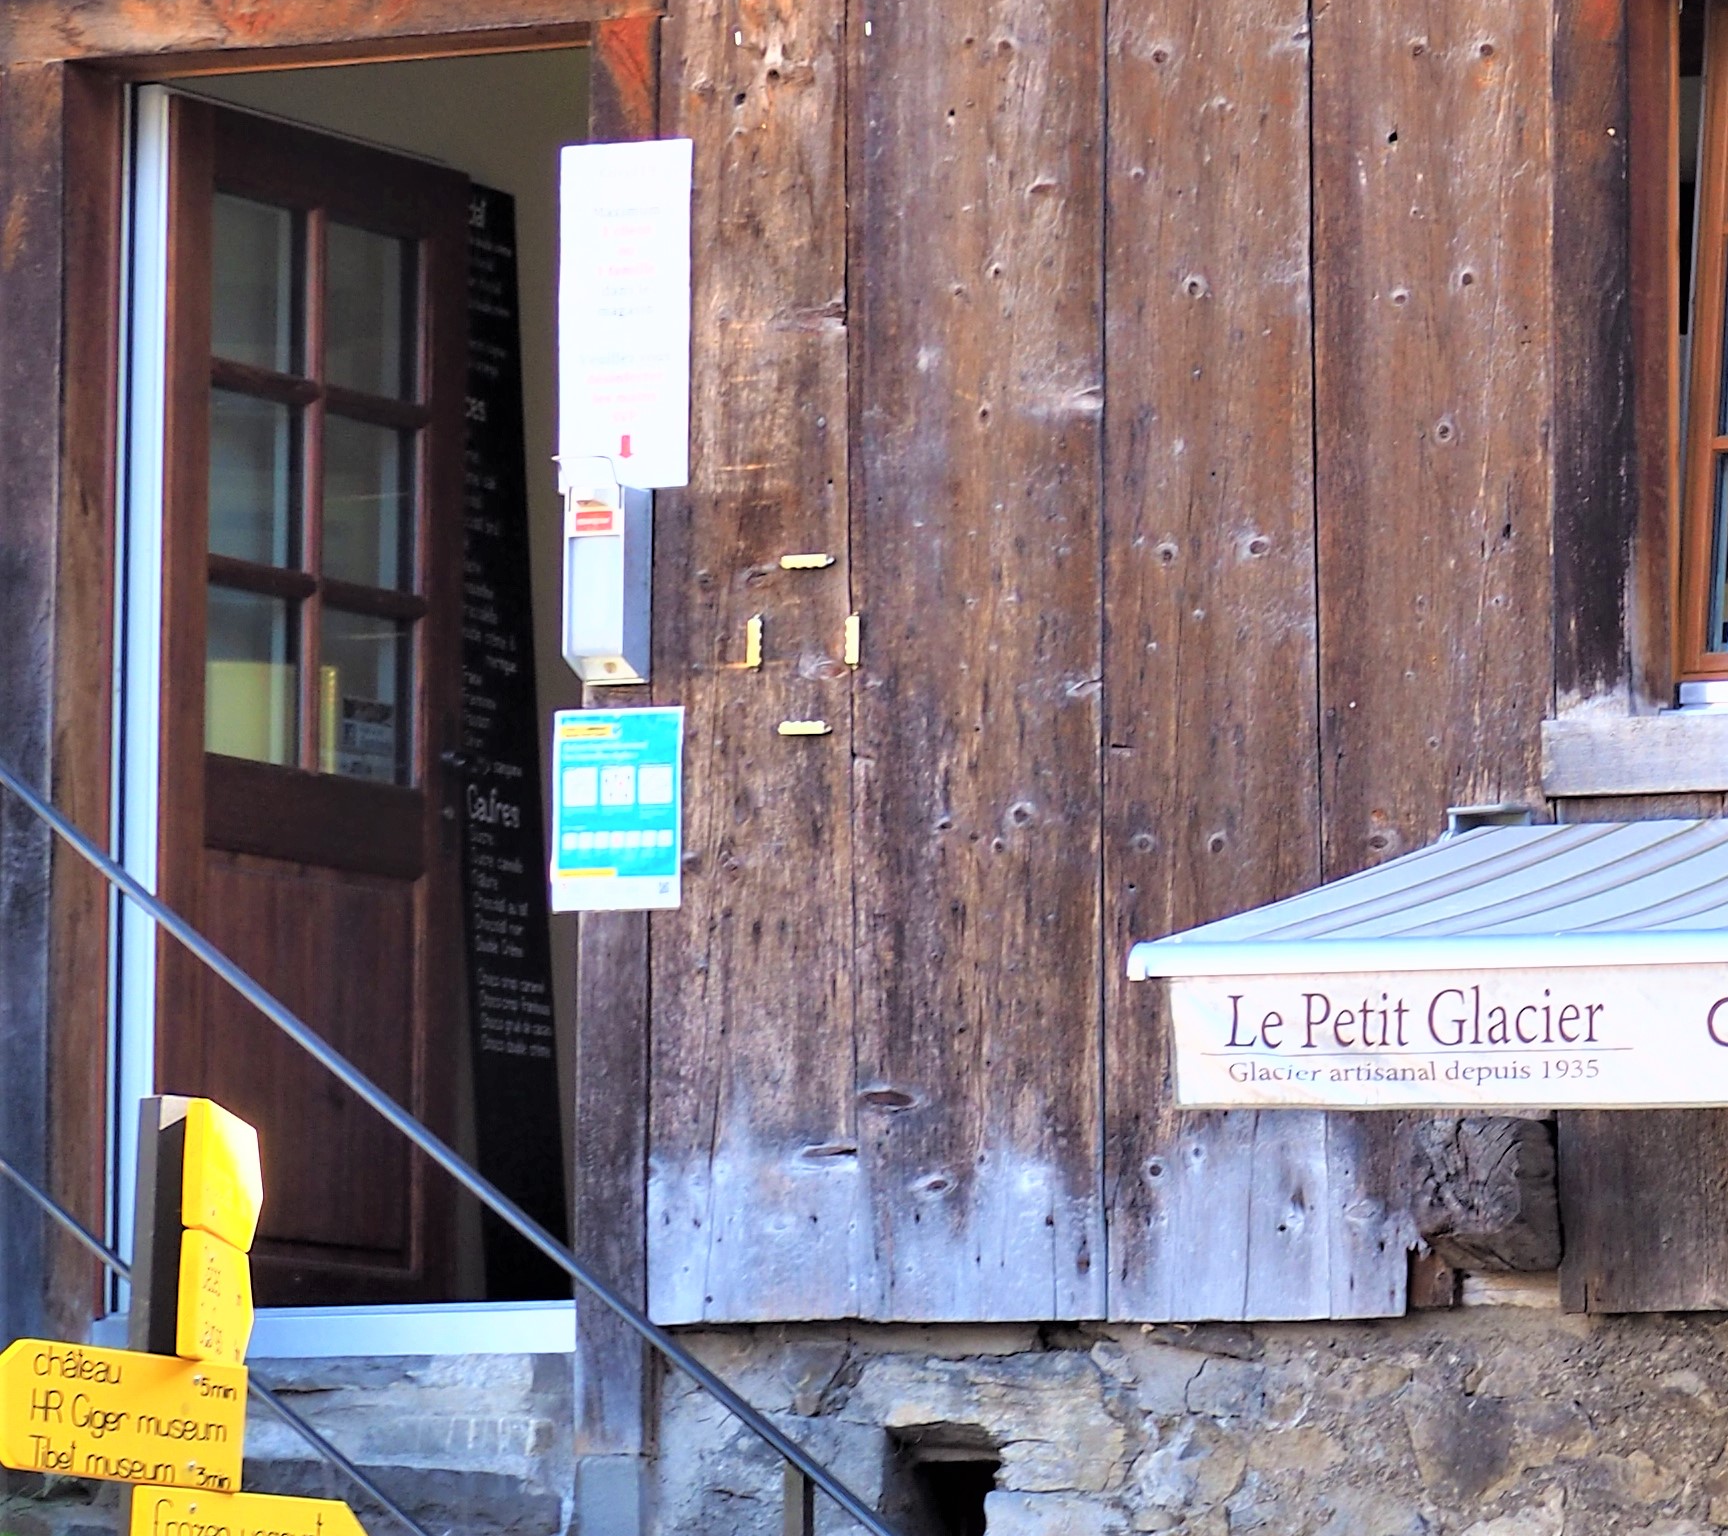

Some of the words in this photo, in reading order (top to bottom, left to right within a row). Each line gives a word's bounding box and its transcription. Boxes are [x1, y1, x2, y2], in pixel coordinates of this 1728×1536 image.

[1225, 992, 1283, 1049] Le
[1301, 988, 1410, 1050] Petit
[1427, 985, 1606, 1048] Glacier
[1228, 1059, 1322, 1084] Glacier
[1328, 1058, 1437, 1084] artisanal
[1443, 1057, 1532, 1086] depuis
[1540, 1056, 1600, 1081] 1935
[33, 1346, 122, 1384] château
[30, 1388, 64, 1423] HR
[71, 1393, 130, 1438] Giger
[137, 1415, 227, 1443] museum
[28, 1434, 77, 1470] Tibet
[85, 1453, 175, 1484] museum
